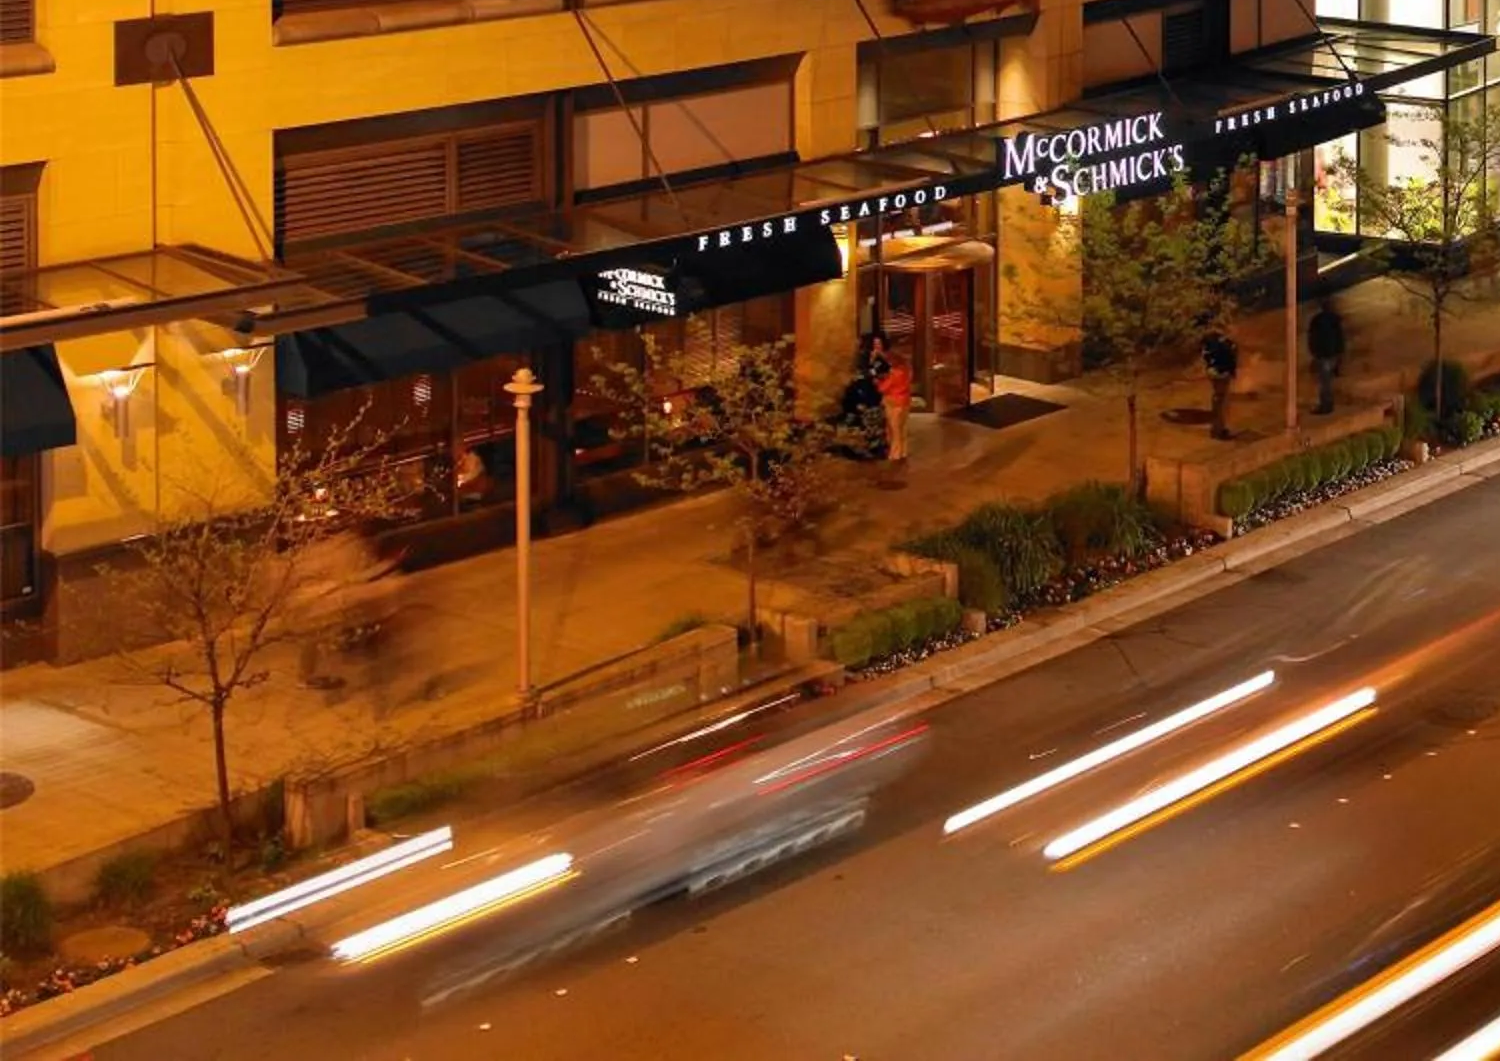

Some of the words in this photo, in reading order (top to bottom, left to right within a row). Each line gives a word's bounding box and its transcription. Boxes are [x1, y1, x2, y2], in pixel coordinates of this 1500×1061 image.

[1215, 106, 1276, 134] FRESH
[1289, 82, 1364, 114] SEAFOOD
[1033, 175, 1049, 194] &
[698, 216, 797, 251] FRESH
[820, 186, 946, 225] SEAFOOD
